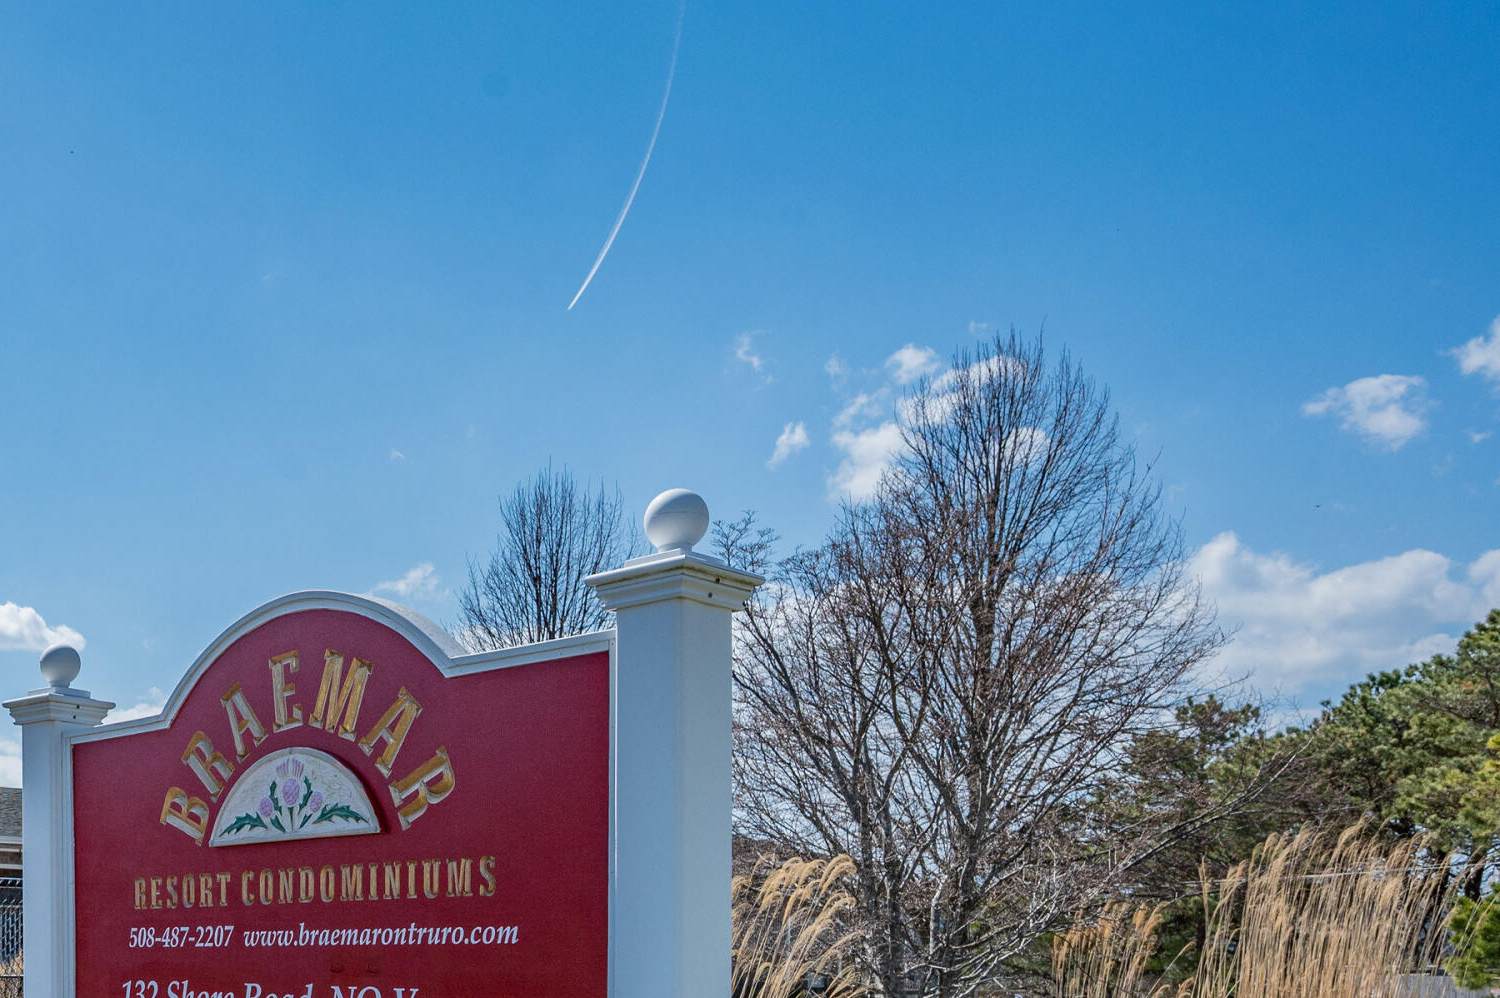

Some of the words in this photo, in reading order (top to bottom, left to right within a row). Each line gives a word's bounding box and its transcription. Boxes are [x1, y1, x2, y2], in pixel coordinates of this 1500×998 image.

[160, 648, 455, 846] BRAEMAR
[134, 871, 231, 910] RESORT
[242, 855, 496, 906] CONDOMINIUMS
[129, 925, 234, 948] 508-487-2207
[244, 922, 518, 947] www.braemarontruro.com
